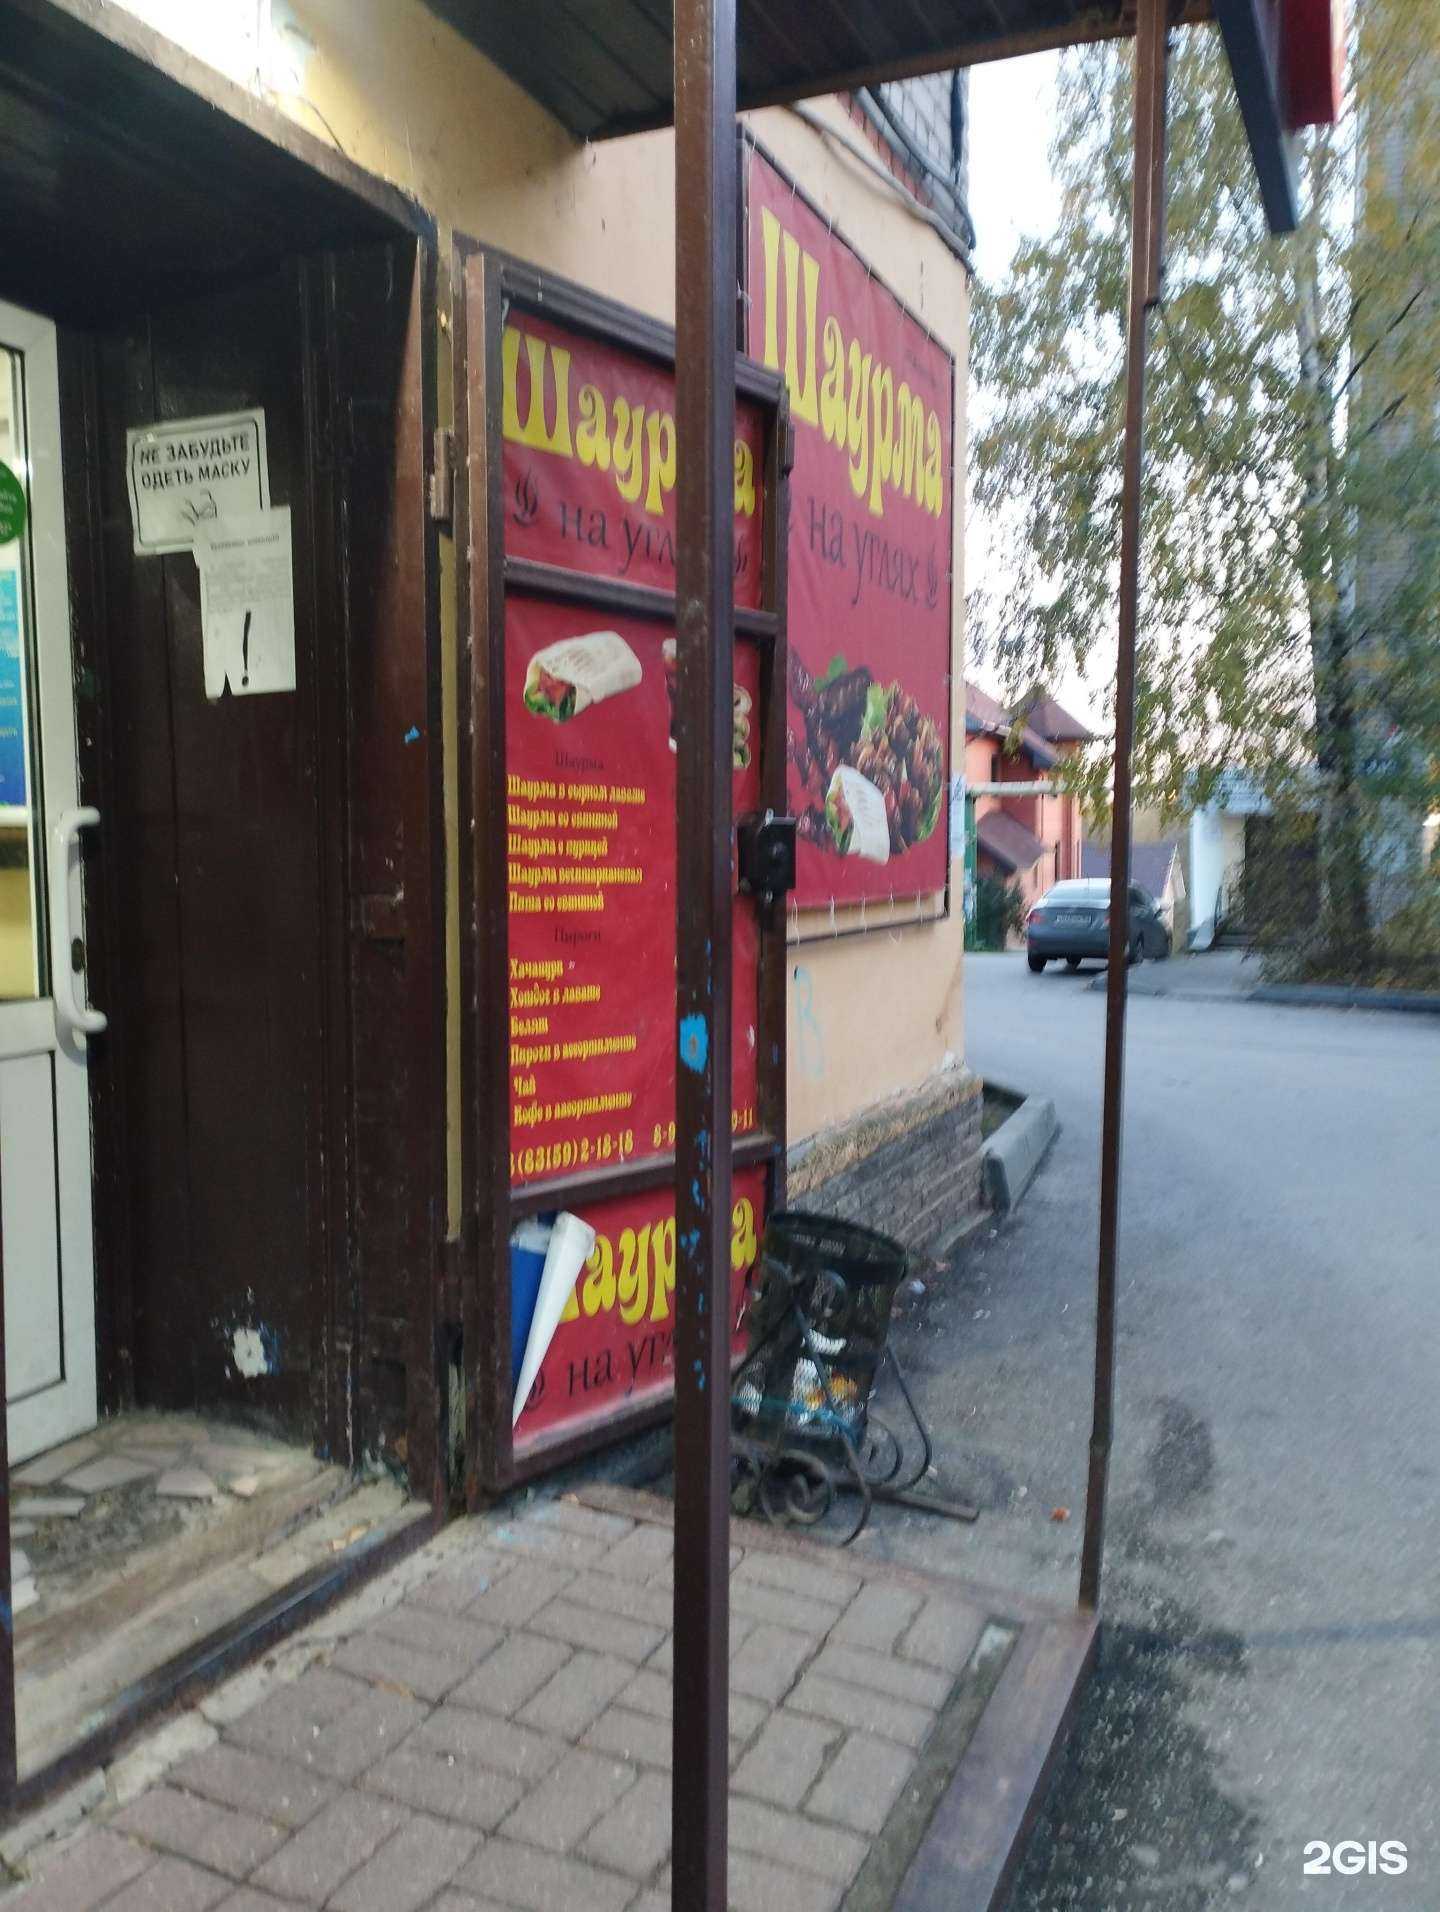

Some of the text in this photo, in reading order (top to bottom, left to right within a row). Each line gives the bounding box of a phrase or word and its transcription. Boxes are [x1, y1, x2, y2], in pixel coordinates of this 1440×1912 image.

[762, 205, 944, 519] Шаурма
[502, 326, 756, 518] Шаура
[140, 432, 249, 465] НЕ ЗАБУДЬТЕ
[141, 457, 250, 490] ОДЕТЬ МАСКУ
[560, 501, 676, 575] на угл
[807, 496, 920, 606] на углях
[507, 774, 557, 803] Шаурма
[507, 804, 557, 831] Шаурма
[507, 833, 557, 860] Шаурма
[507, 862, 558, 889] Шаурма
[513, 1073, 536, 1098] Чай
[560, 1198, 758, 1327] аура
[567, 1347, 613, 1398] на
